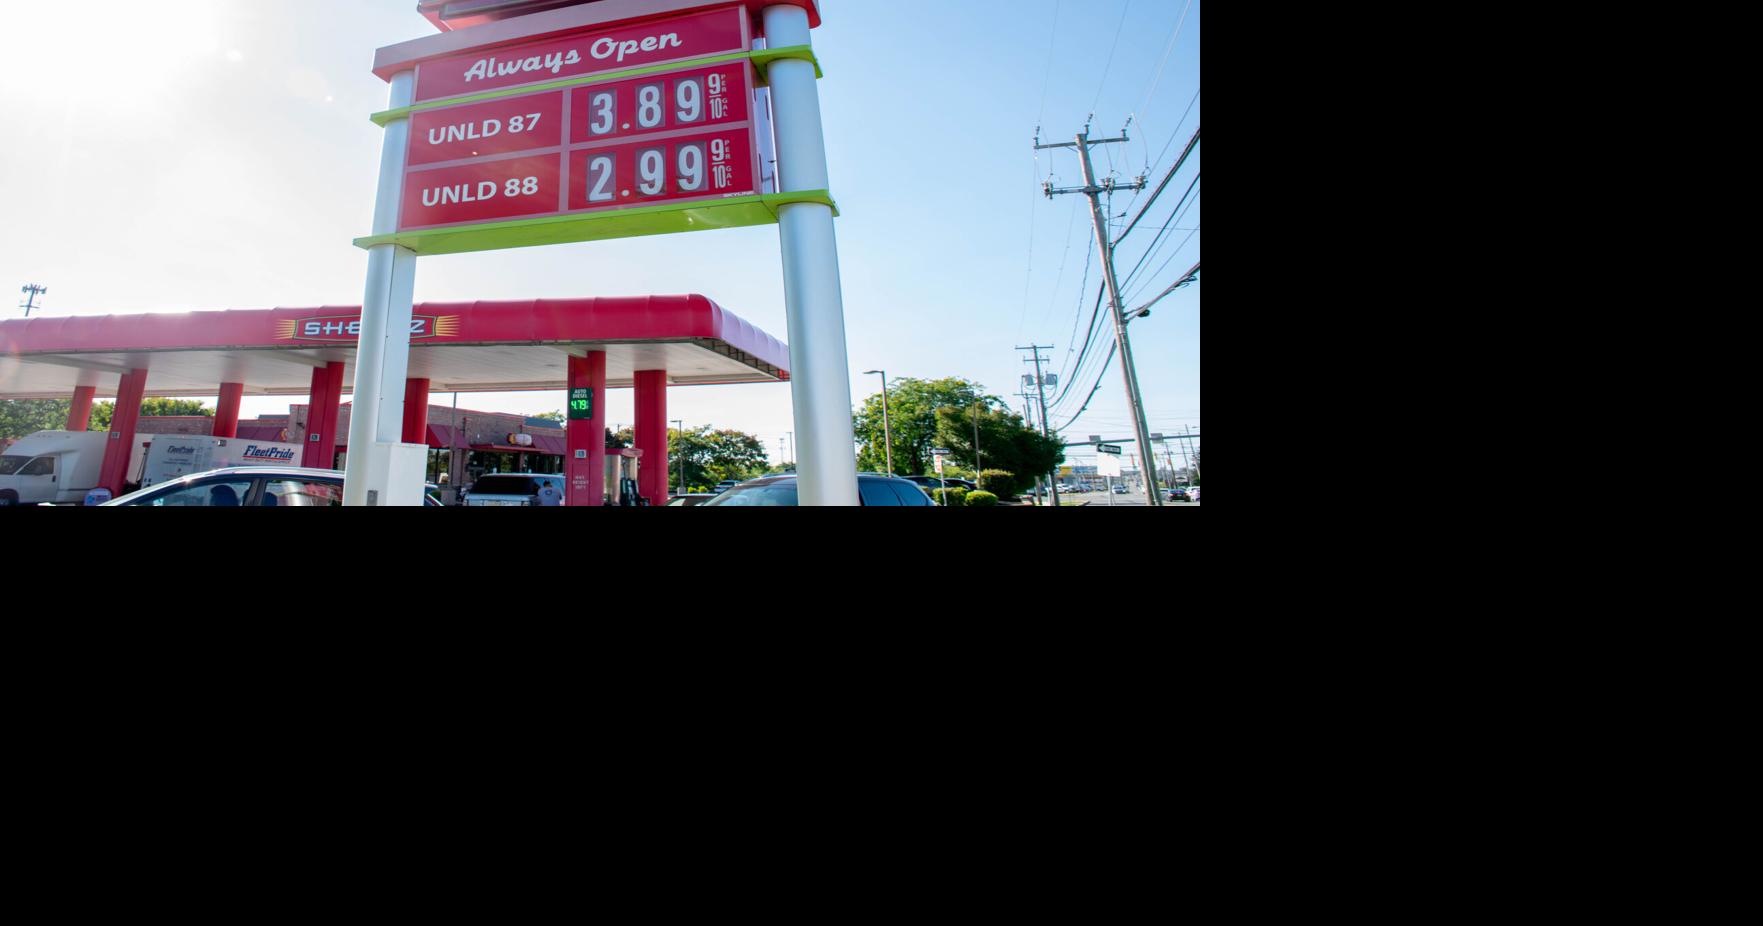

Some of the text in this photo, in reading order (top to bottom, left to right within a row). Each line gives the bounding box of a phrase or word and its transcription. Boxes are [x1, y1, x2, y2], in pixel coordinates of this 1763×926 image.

[464, 32, 682, 82] Always Open
[591, 80, 700, 134] 3.89
[428, 112, 541, 145] UNLD 87
[589, 145, 703, 201] 2.99
[422, 176, 538, 206] UNLD 88
[304, 319, 426, 335] SHEZ
[243, 445, 294, 459] FleetPride
